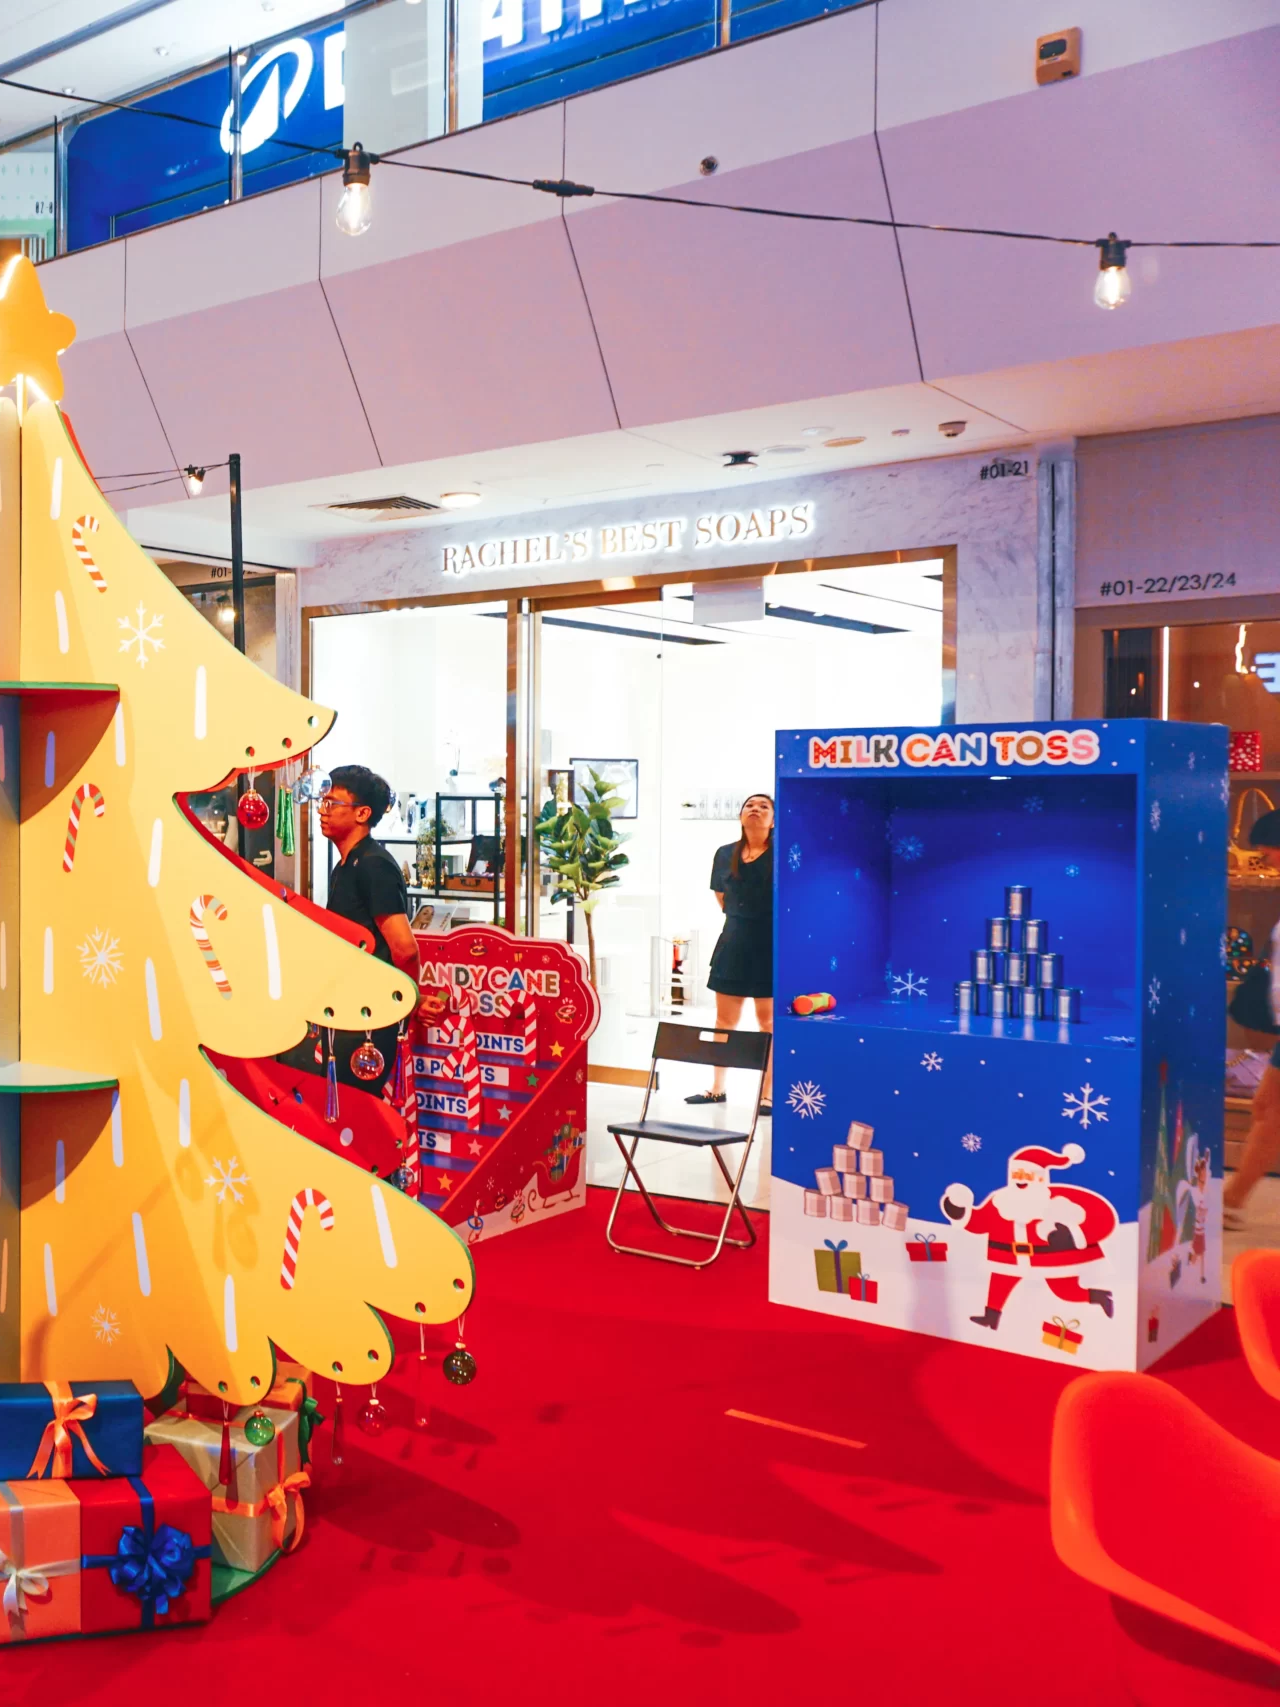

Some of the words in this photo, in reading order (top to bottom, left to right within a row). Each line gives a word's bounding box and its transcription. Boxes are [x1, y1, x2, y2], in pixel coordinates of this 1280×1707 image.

[980, 461, 1029, 480] #01-21
[441, 531, 589, 575] RACHEL'S
[600, 520, 683, 555] BEST
[694, 504, 811, 546] SOAPS
[1099, 572, 1237, 597] #01-22/23/24
[813, 739, 895, 765] MILK
[905, 737, 983, 763] CAN
[995, 734, 1095, 762] TOSS
[421, 966, 486, 987] ANDY
[489, 970, 558, 993] CANE
[475, 1034, 524, 1053] OINTS
[415, 1057, 424, 1073] 8
[416, 1092, 467, 1114] OINTS
